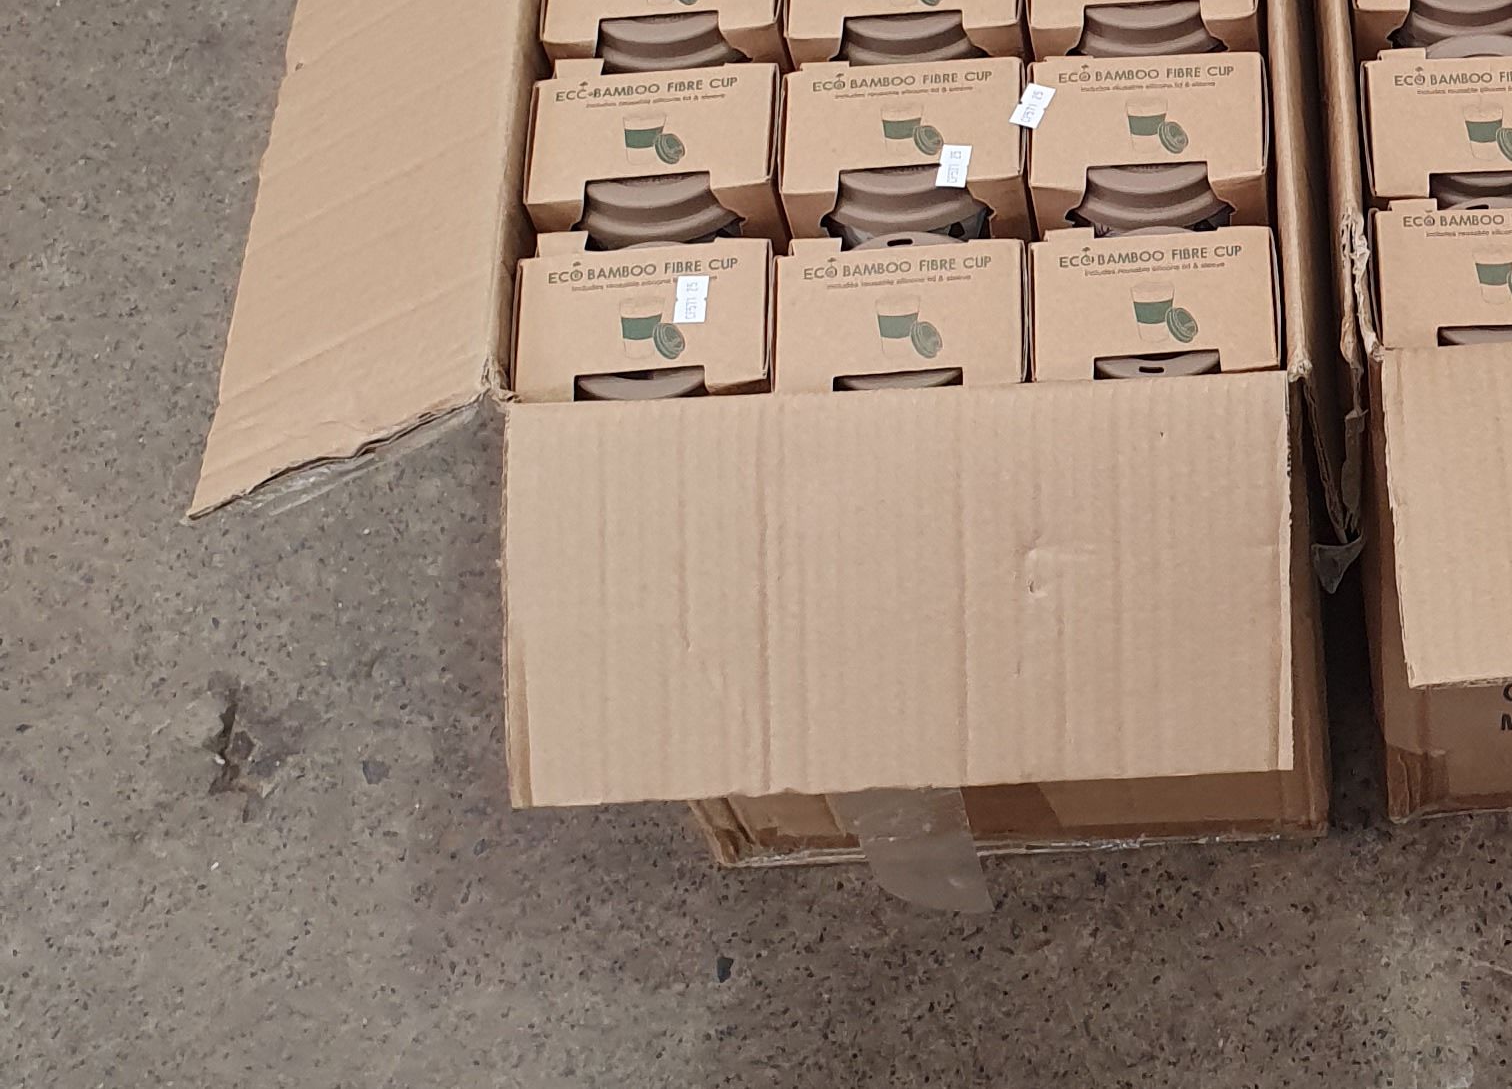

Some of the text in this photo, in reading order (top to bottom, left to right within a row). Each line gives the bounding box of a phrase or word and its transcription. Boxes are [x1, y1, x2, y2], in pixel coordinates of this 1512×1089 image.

[811, 76, 847, 93] ECO
[848, 74, 917, 90] BAMBOO
[921, 71, 959, 85] FIBRE
[963, 69, 993, 83] CUP
[1057, 64, 1235, 84] ECO BAMBOO FIBRE CUP
[1393, 71, 1427, 87] ECO
[1428, 71, 1494, 86] BAMBOO
[593, 82, 661, 99] BAMBOO
[665, 78, 704, 93] FIBRE
[707, 75, 739, 90] CUP
[1401, 212, 1437, 228] ECO
[1438, 213, 1505, 227] BAMBOO
[1096, 249, 1165, 266] BAMBOO
[1170, 245, 1208, 261] FIBRE
[1212, 244, 1243, 258] CUP
[547, 266, 584, 285] ECO
[586, 262, 658, 281] BAMBOO
[663, 259, 702, 275] FIBRE
[707, 256, 739, 271] CUP
[802, 262, 839, 281] ECO
[841, 260, 912, 278] BAMBOO
[918, 256, 957, 272] FIBRE
[961, 254, 992, 270] CUP
